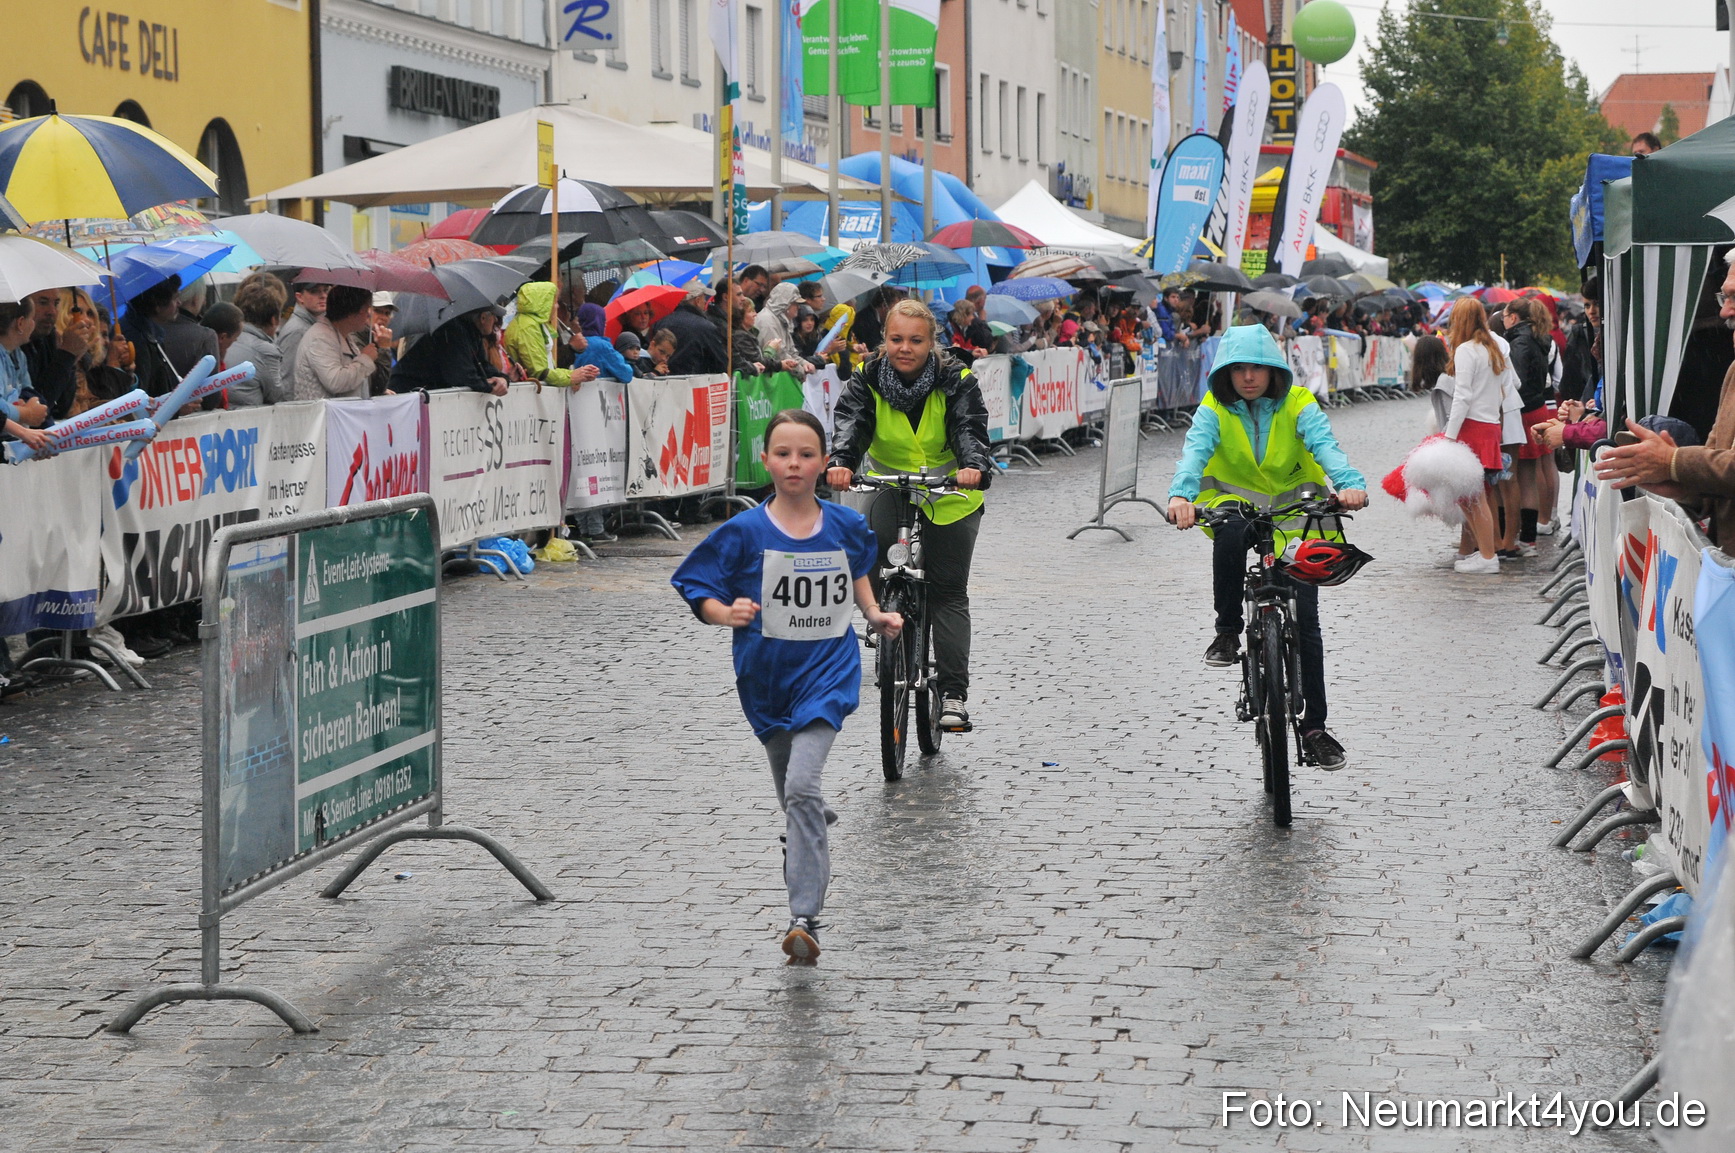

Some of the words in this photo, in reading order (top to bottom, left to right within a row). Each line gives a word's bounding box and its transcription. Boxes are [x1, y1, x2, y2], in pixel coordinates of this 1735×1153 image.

[78, 6, 130, 71] CAFE
[139, 19, 179, 82] DELI
[399, 66, 453, 117] BRILLEN
[454, 77, 501, 122] WEBER
[1178, 162, 1211, 181] maxi
[1194, 190, 1207, 202] dsl
[1234, 198, 1246, 248] Audi
[1240, 153, 1251, 195] BKK
[1292, 208, 1309, 254] Audi
[1303, 165, 1318, 205] BKK
[189, 370, 248, 399] eiseCenter
[1028, 364, 1074, 419] Oberbank
[74, 397, 143, 433] ReiseCenter
[74, 427, 147, 447] ReiseCenter
[443, 426, 484, 458] RECHTS
[139, 427, 259, 511] INTERSPORT
[323, 551, 390, 586] Event-Leit-Systeme
[793, 556, 832, 567] BOCK
[772, 573, 848, 609] 4013
[788, 614, 832, 628] Andrea
[303, 653, 325, 698] Fun
[328, 646, 338, 689] &
[341, 635, 378, 686] Action
[381, 629, 392, 672] in
[303, 711, 352, 763] sicheren
[355, 686, 400, 743] Bahnen!
[330, 791, 356, 826] Service
[356, 784, 374, 813] Line:
[374, 772, 395, 804] 09181
[395, 764, 412, 795] 6352
